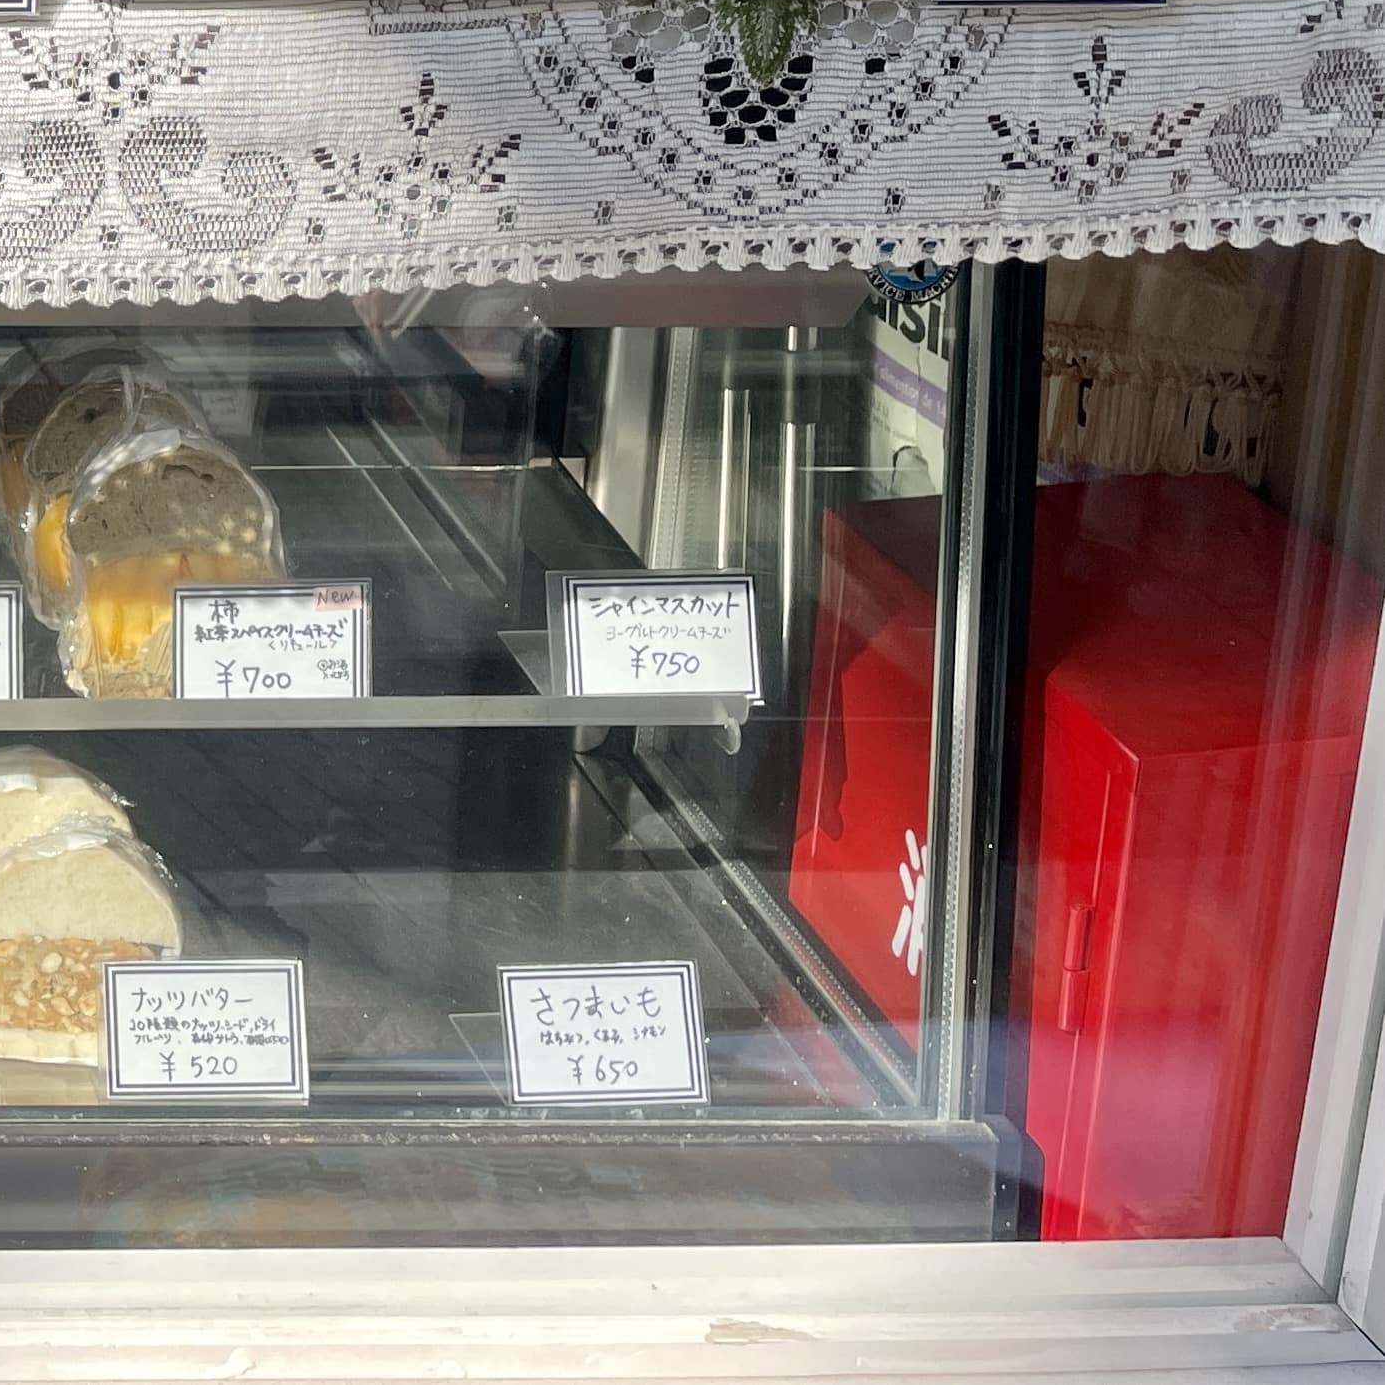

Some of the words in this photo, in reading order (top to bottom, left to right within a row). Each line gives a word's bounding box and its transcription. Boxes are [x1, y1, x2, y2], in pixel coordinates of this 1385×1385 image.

[208, 600, 240, 624] 柿
[588, 592, 740, 619] シャインマスカット
[606, 622, 731, 641] ヨーグルトクリームチーズ
[629, 644, 701, 679] ¥750
[215, 659, 292, 698] ¥700
[130, 987, 253, 1013] ナッツバター
[530, 985, 661, 1026] さつまいも
[159, 1051, 238, 1082] ¥520
[567, 1055, 638, 1085] ¥650
